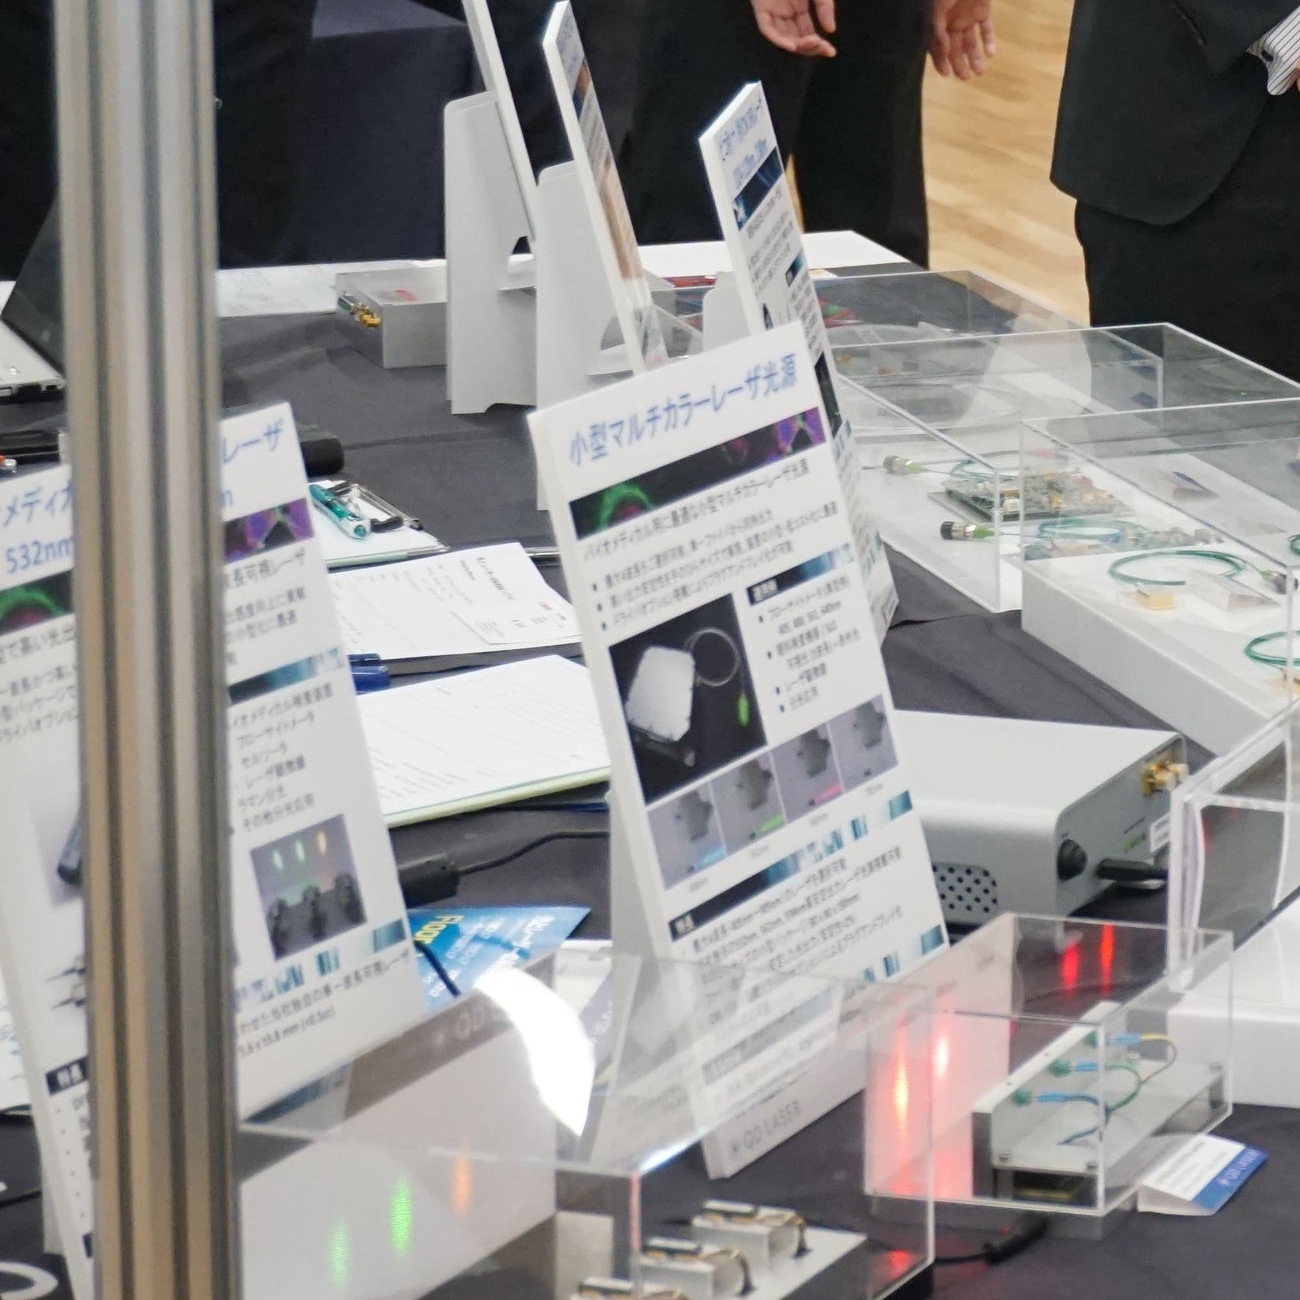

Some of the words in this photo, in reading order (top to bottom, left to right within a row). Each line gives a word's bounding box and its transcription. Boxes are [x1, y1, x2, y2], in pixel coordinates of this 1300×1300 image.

[569, 353, 800, 469] 小型マルチカラーレーザ光源
